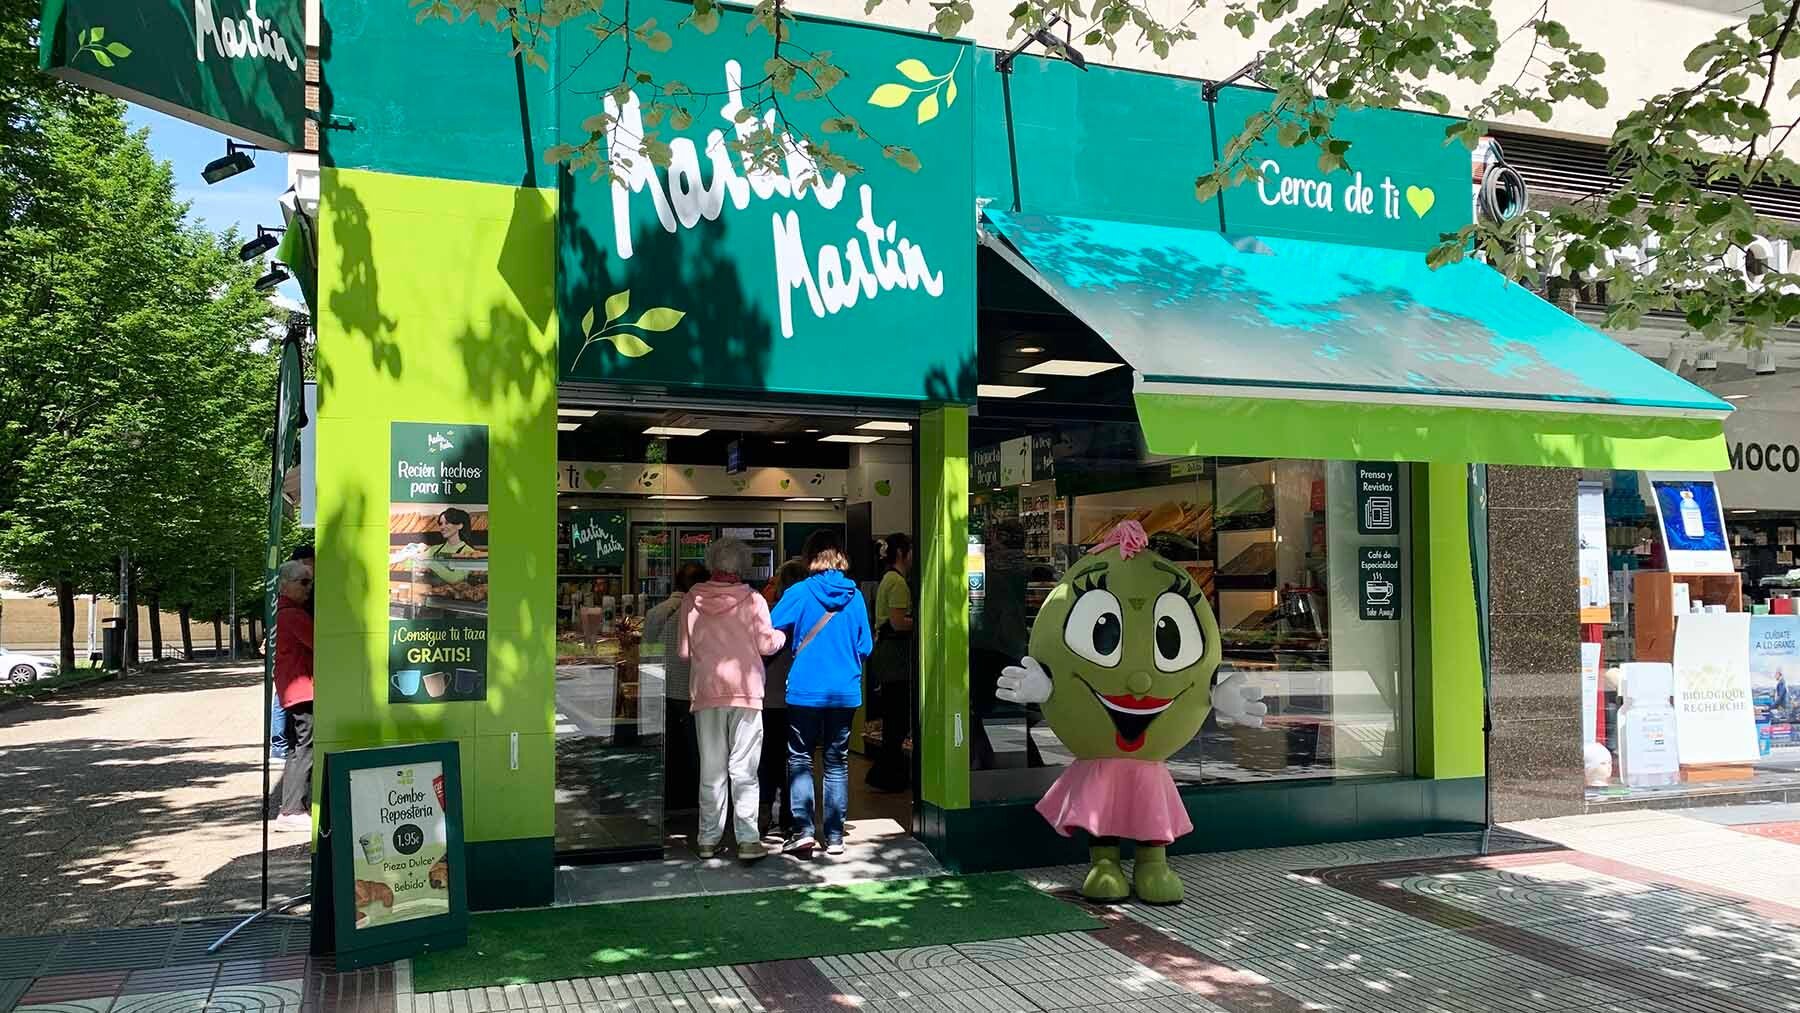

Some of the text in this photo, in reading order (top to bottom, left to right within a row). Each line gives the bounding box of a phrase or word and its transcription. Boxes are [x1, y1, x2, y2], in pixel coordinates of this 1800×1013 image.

[1257, 159, 1400, 219] Cerca de ti
[398, 460, 482, 479] Recién hechos
[565, 464, 580, 488] ti
[1360, 469, 1393, 481] Prensa y
[410, 479, 453, 498] para ti
[1363, 481, 1393, 491] Revistas
[392, 626, 486, 647] ¡Consigue tu taza
[407, 647, 471, 663] GRATIS!
[388, 787, 426, 806] Combo
